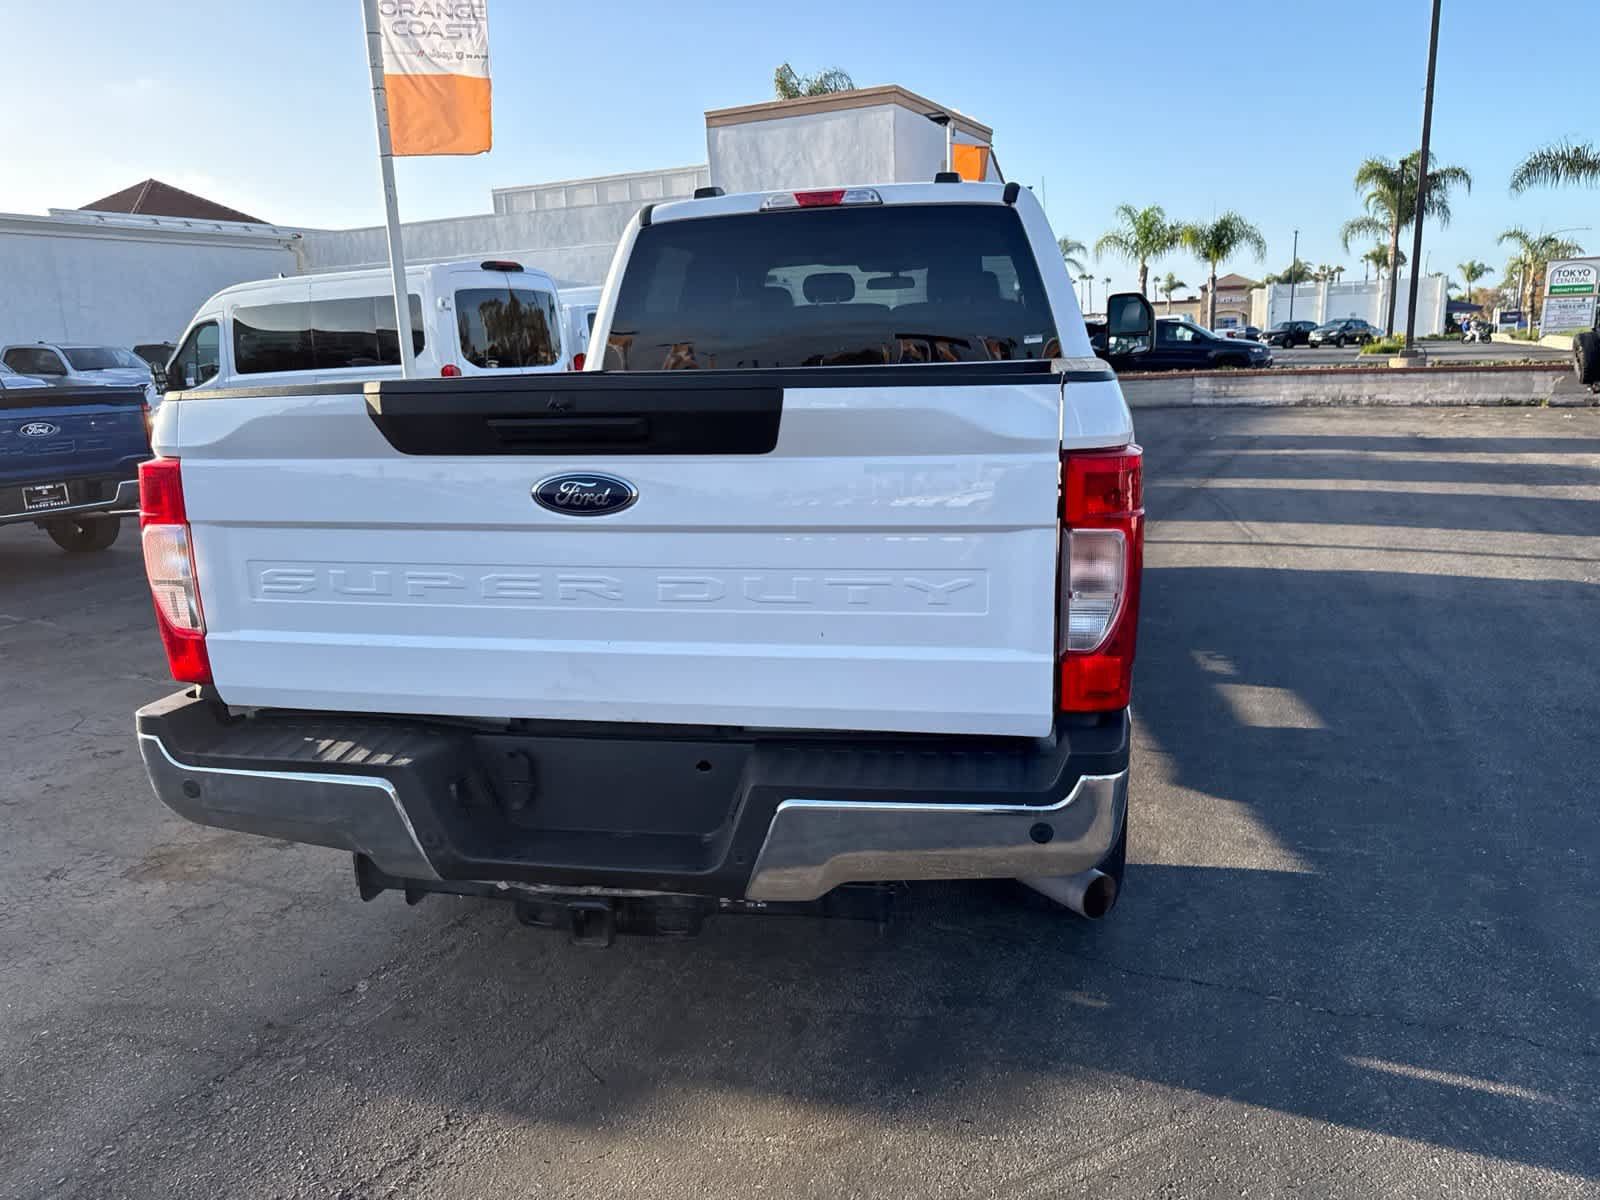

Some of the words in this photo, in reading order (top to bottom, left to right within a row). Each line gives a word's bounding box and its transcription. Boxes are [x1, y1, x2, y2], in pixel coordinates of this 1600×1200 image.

[380, 0, 486, 21] ORANGE
[392, 20, 478, 40] COAST
[1556, 269, 1591, 278] TOKYO
[26, 424, 49, 435] Ford
[554, 481, 611, 505] Ford
[260, 567, 624, 601] SUPER
[657, 576, 976, 606] DUTY
